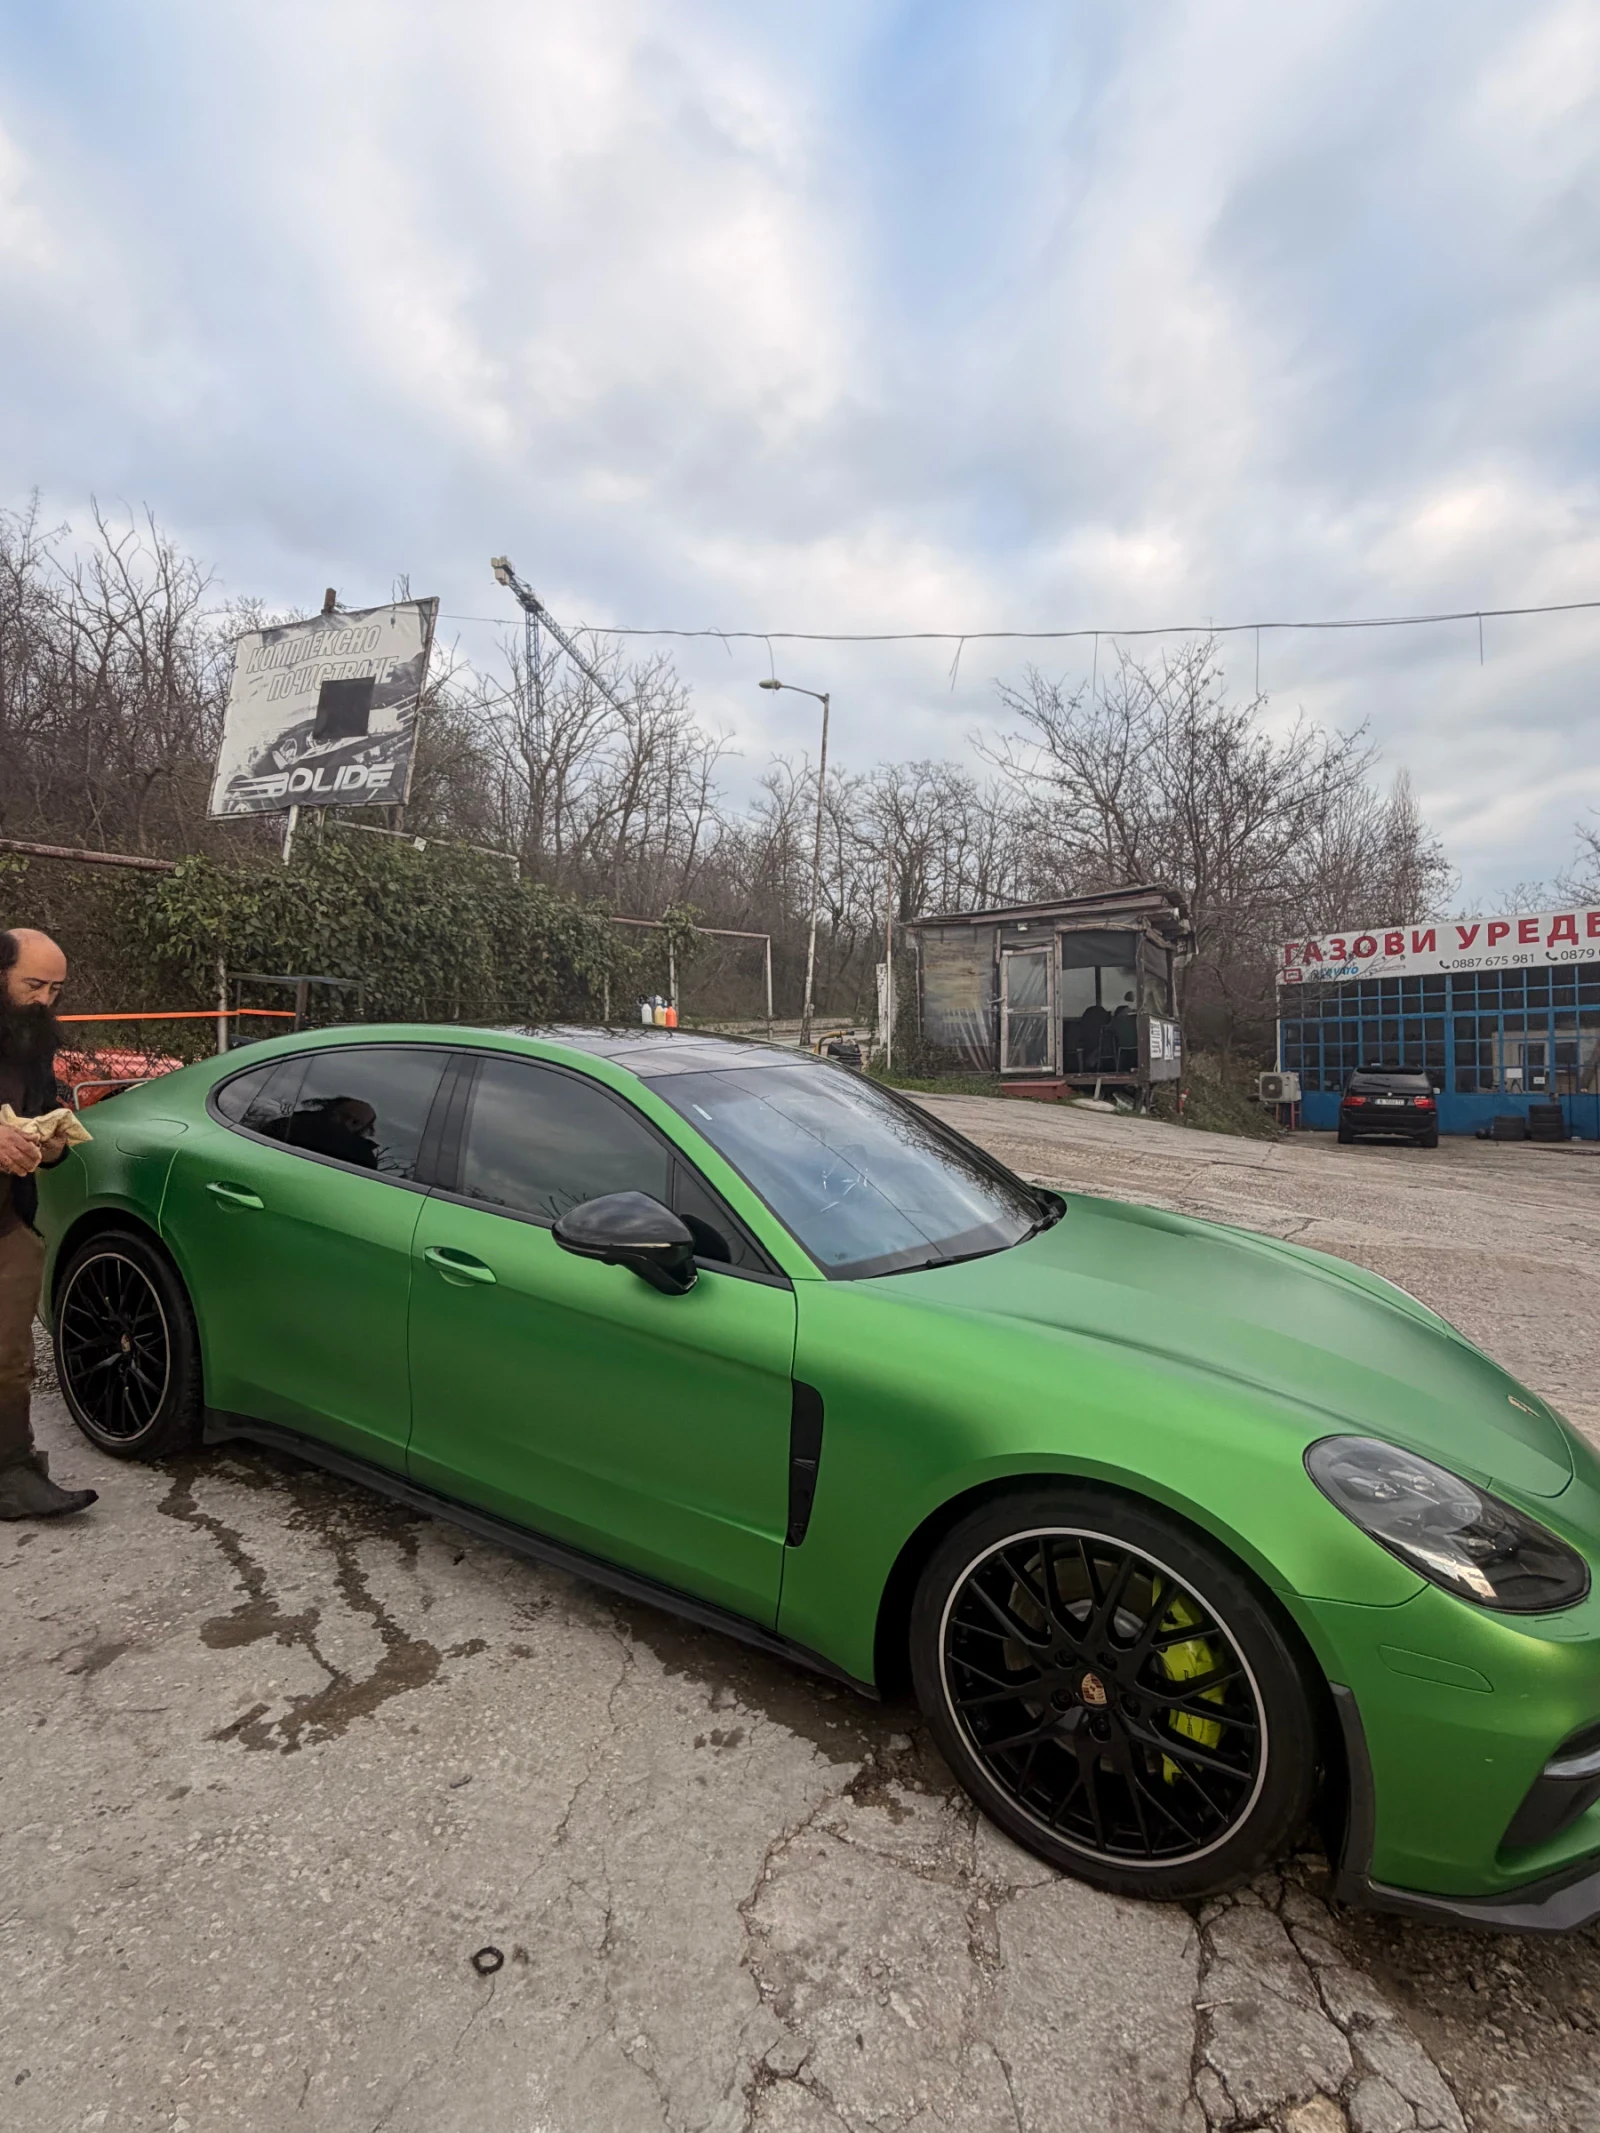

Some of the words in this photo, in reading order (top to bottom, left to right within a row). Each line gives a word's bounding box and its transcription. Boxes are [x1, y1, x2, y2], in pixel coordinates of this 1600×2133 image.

[246, 625, 381, 674] КОМПЛЕКСНО
[266, 655, 399, 701] ПОЧИСТВАНЕ
[228, 763, 396, 799] BOLIDE
[1284, 928, 1436, 966] ГАЗОВИ
[1452, 957, 1482, 969] 0887
[1485, 955, 1508, 967] 675
[1512, 953, 1535, 964] 981
[1560, 948, 1595, 961] 0879
